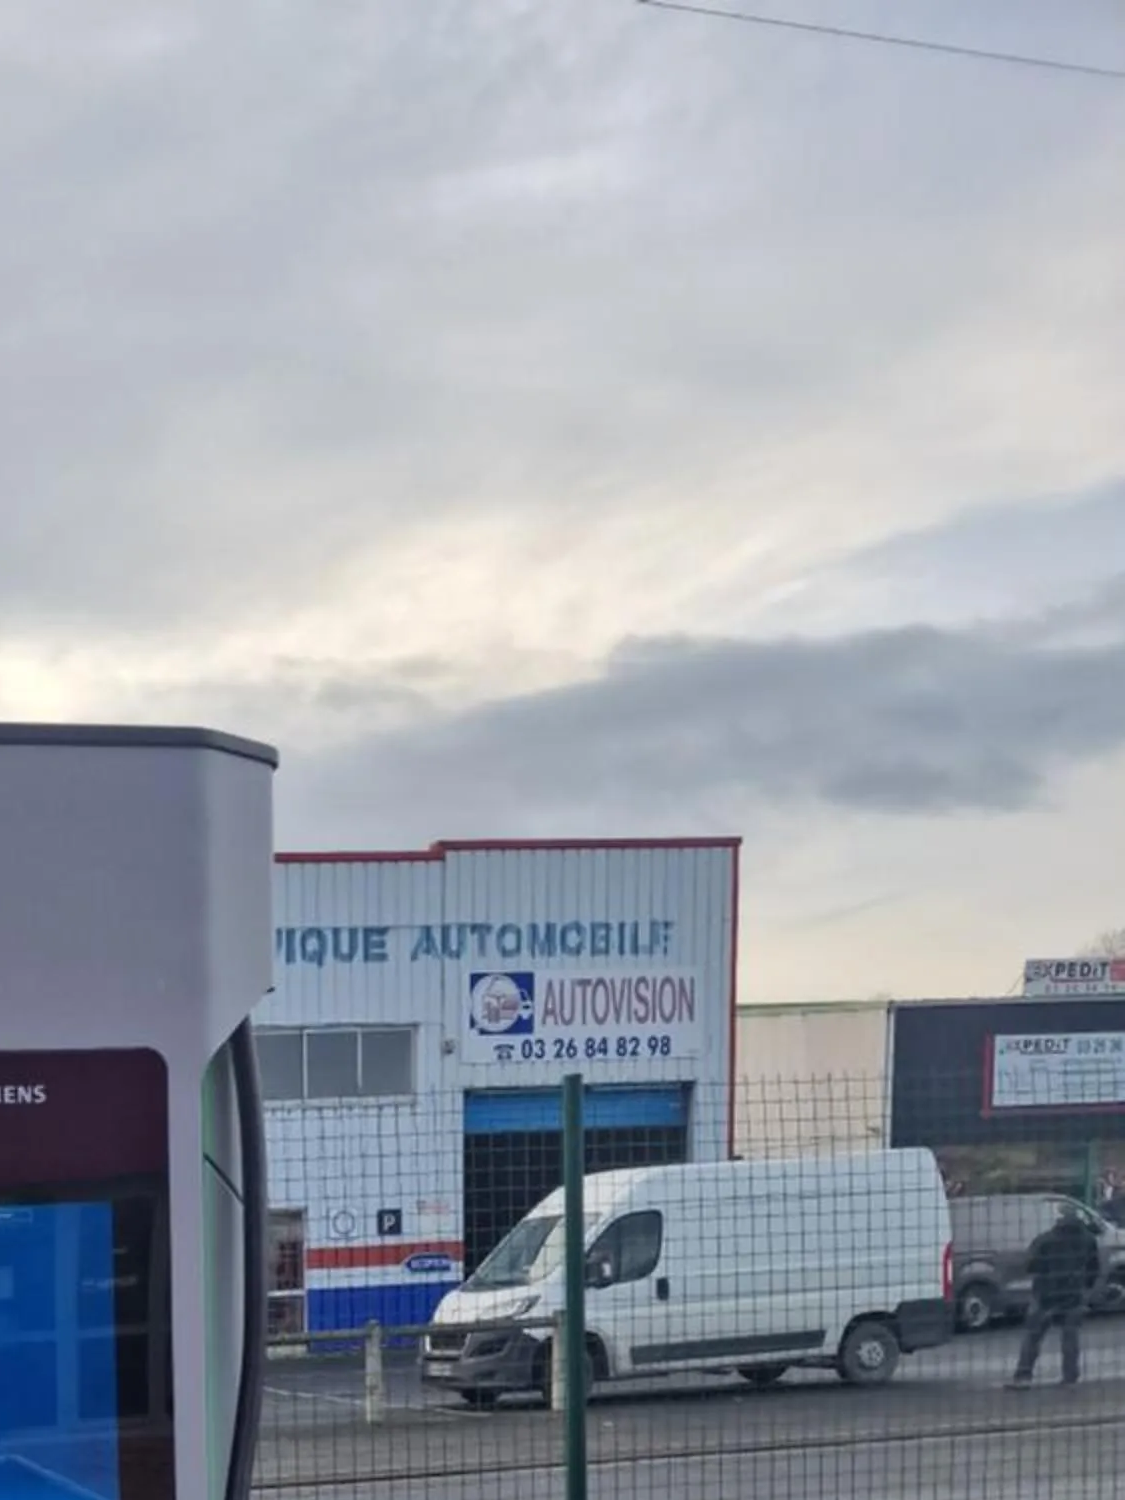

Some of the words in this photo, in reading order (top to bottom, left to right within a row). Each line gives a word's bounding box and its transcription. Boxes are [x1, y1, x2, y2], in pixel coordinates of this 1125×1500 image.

[541, 976, 695, 1026] AUTOVISION
[521, 1039, 545, 1059] 03
[553, 1037, 577, 1059] 26
[585, 1037, 608, 1058] 84
[616, 1036, 640, 1057] 82
[647, 1035, 671, 1056] 98
